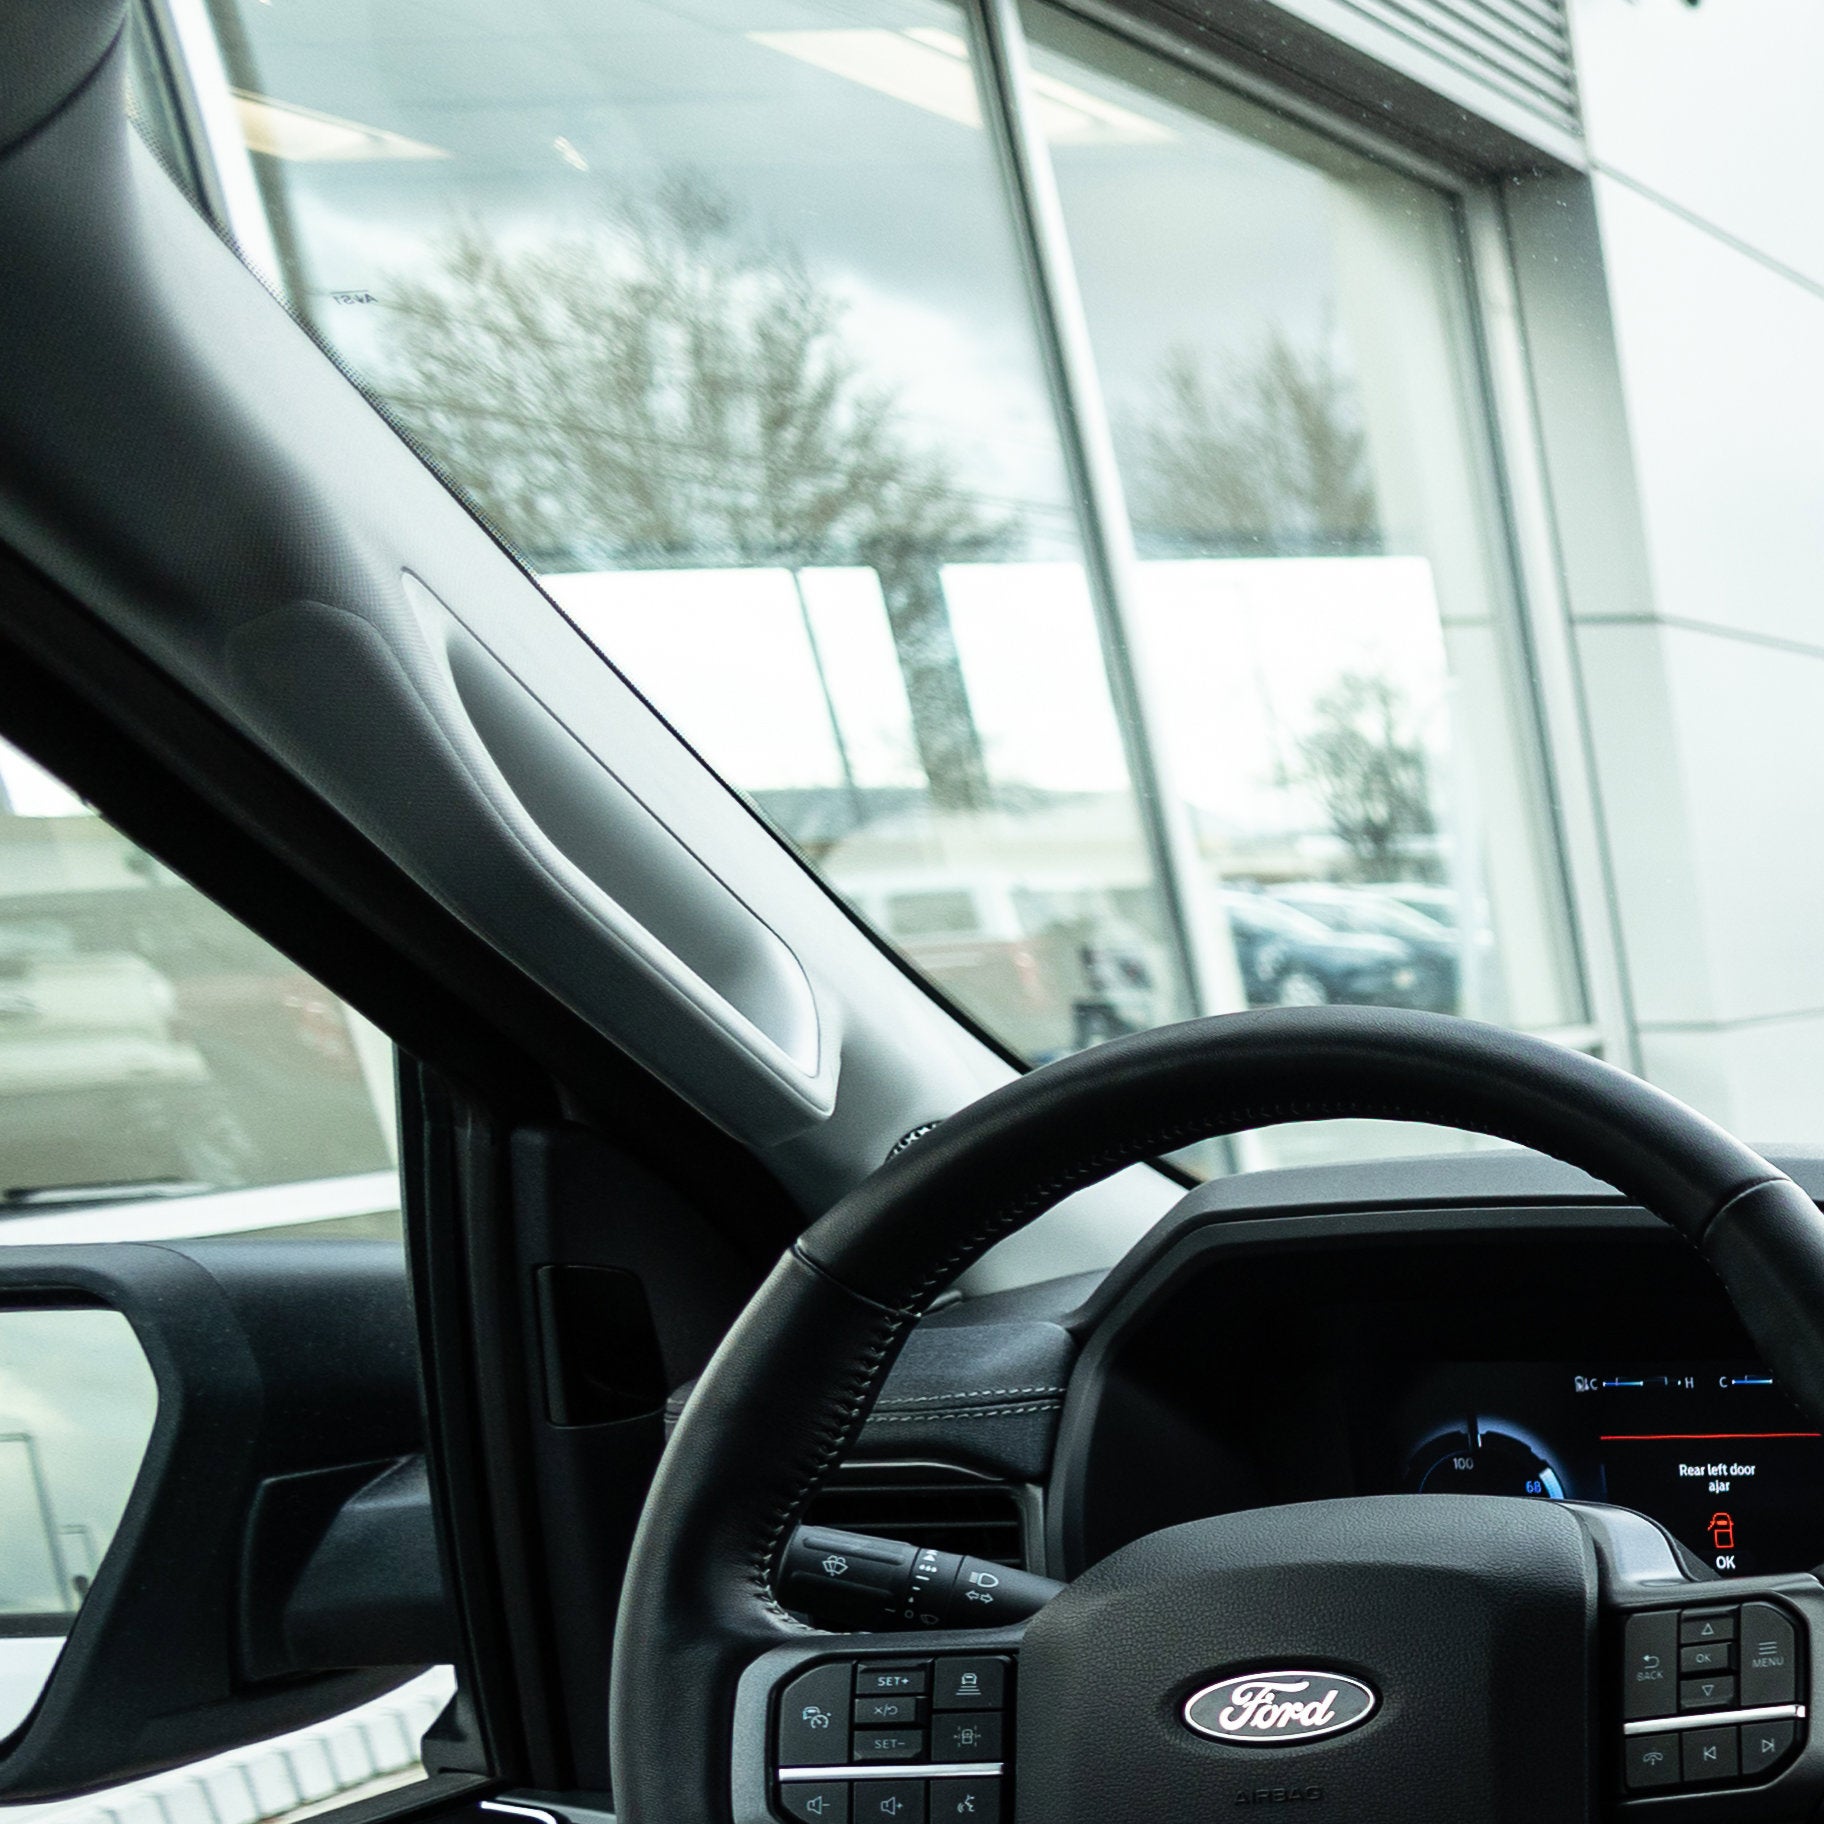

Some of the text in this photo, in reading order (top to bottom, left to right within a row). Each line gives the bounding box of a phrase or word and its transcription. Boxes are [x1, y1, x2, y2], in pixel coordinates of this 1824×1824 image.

[1719, 1376, 1727, 1388] C
[1453, 1458, 1473, 1469] 100
[1679, 1463, 1755, 1476] Rear left door
[1709, 1480, 1730, 1493] ajar
[1715, 1555, 1736, 1571] OK
[1695, 1653, 1712, 1664] OK
[1752, 1656, 1784, 1668] MENU
[878, 1677, 909, 1686] SET+
[1636, 1671, 1663, 1682] BACK
[1217, 1679, 1341, 1732] Ford
